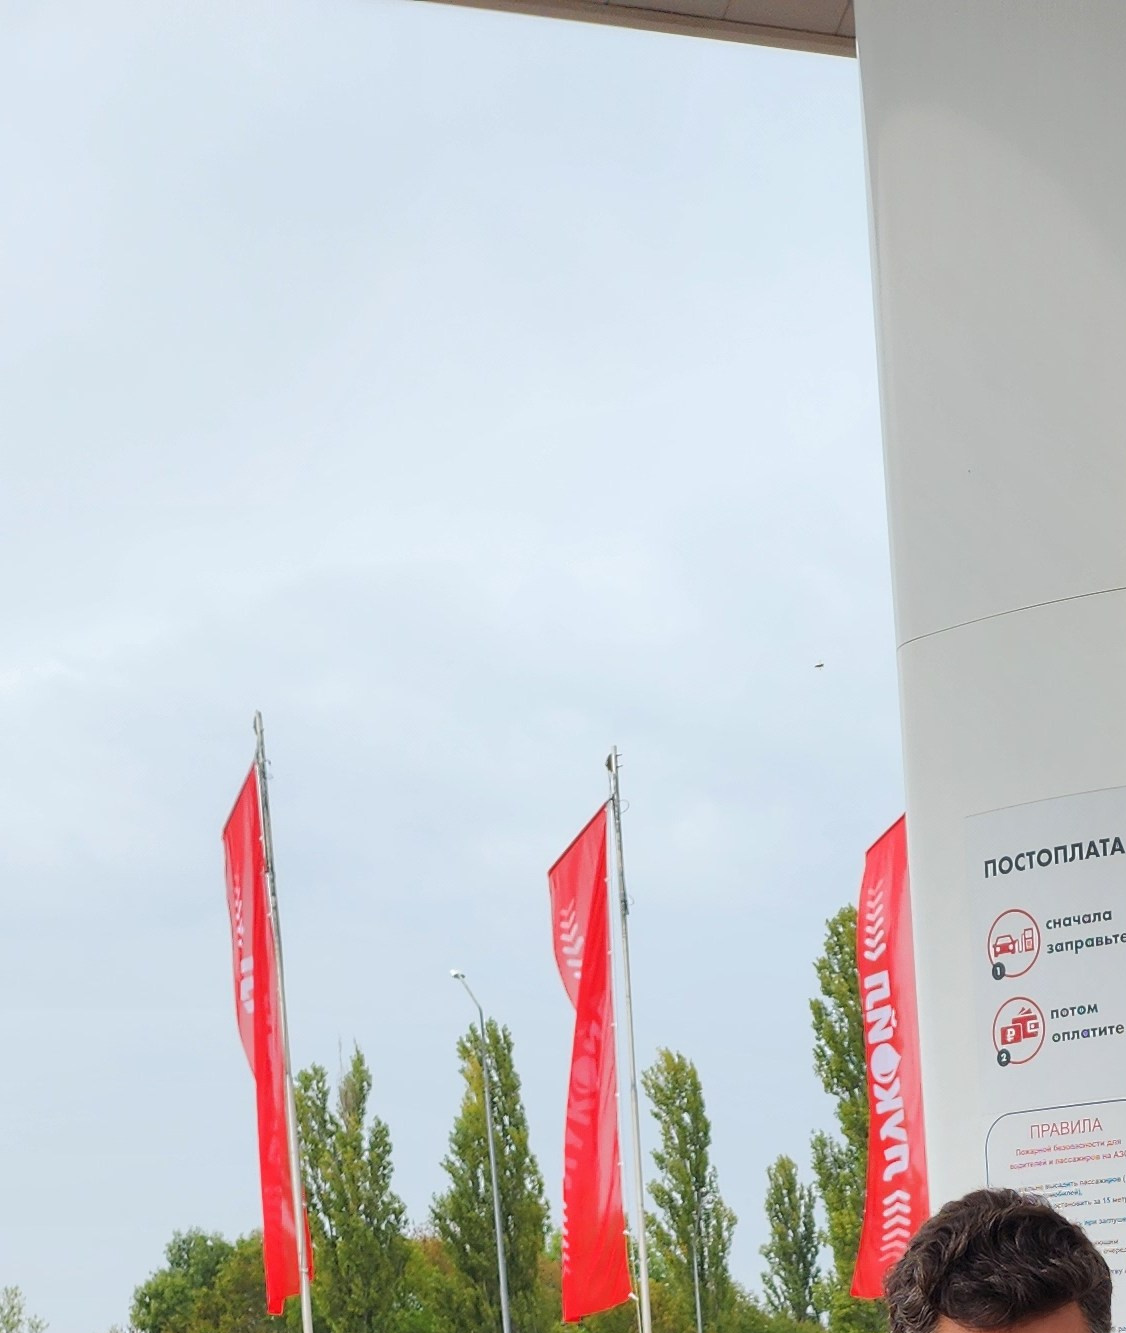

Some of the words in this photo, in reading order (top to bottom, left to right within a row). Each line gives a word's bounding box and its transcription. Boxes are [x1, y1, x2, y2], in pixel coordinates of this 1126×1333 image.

[984, 836, 1126, 879] ПОСТОПЛАТА
[1046, 910, 1112, 930] сначала
[1050, 1003, 1099, 1020] потом
[1052, 1023, 1125, 1043] оплатите
[1030, 1117, 1103, 1139] ПРАВИЛА
[1103, 1196, 1111, 1204] 15
